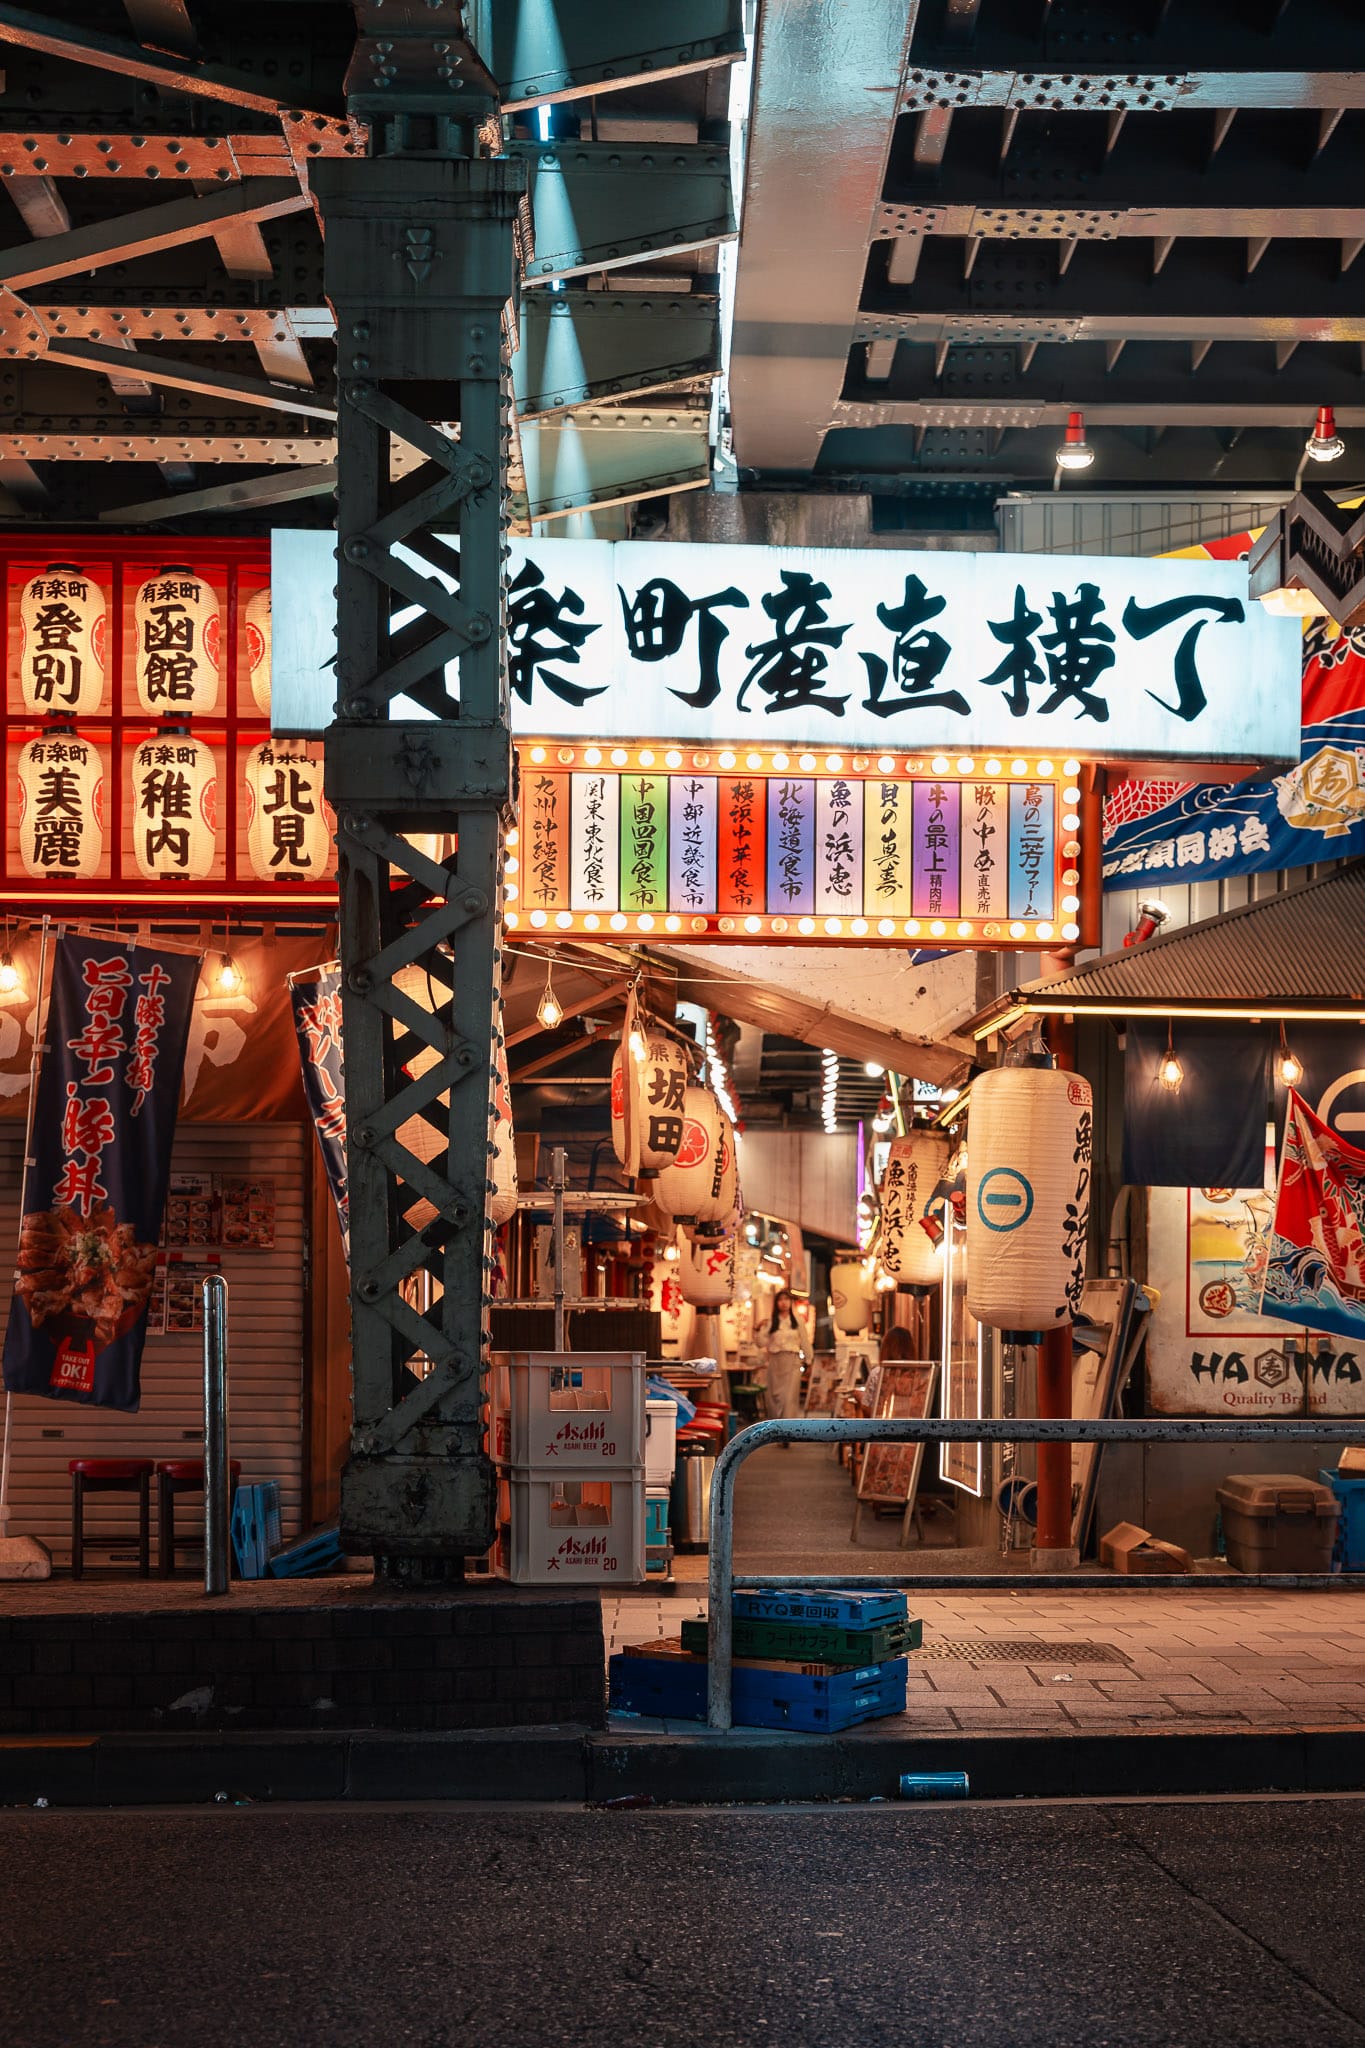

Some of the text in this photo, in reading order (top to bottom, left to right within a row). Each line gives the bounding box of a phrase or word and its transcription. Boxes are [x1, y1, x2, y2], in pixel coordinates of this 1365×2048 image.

[30, 580, 88, 602] 有楽町
[142, 581, 201, 603] 有楽町
[32, 602, 83, 704] 登別
[144, 603, 199, 702] 函館
[319, 559, 1246, 722] 楽町産直横丁
[29, 742, 88, 767] 有楽町
[139, 744, 198, 768] 有楽町
[33, 766, 84, 867] 美麗
[141, 768, 192, 867] 稚内
[263, 769, 315, 868] 北見
[533, 775, 558, 907] 九州沖縄食市
[584, 778, 605, 903] 関東東北食市
[629, 778, 657, 908] 中国四国食市
[681, 779, 705, 908] 中部近畿食市
[729, 780, 754, 909] 横浜中華食市
[778, 781, 805, 904] 北海道食市
[648, 1067, 687, 1155] 坂田
[60, 1362, 88, 1380] OK!
[1190, 1351, 1249, 1385] HA
[1223, 1391, 1276, 1408] Quality
[545, 1443, 558, 1456] 大
[602, 1442, 616, 1456] 20
[556, 1422, 605, 1441] Asahi
[547, 1558, 560, 1570] 大
[604, 1557, 618, 1570] 20
[558, 1536, 607, 1556] Asahi
